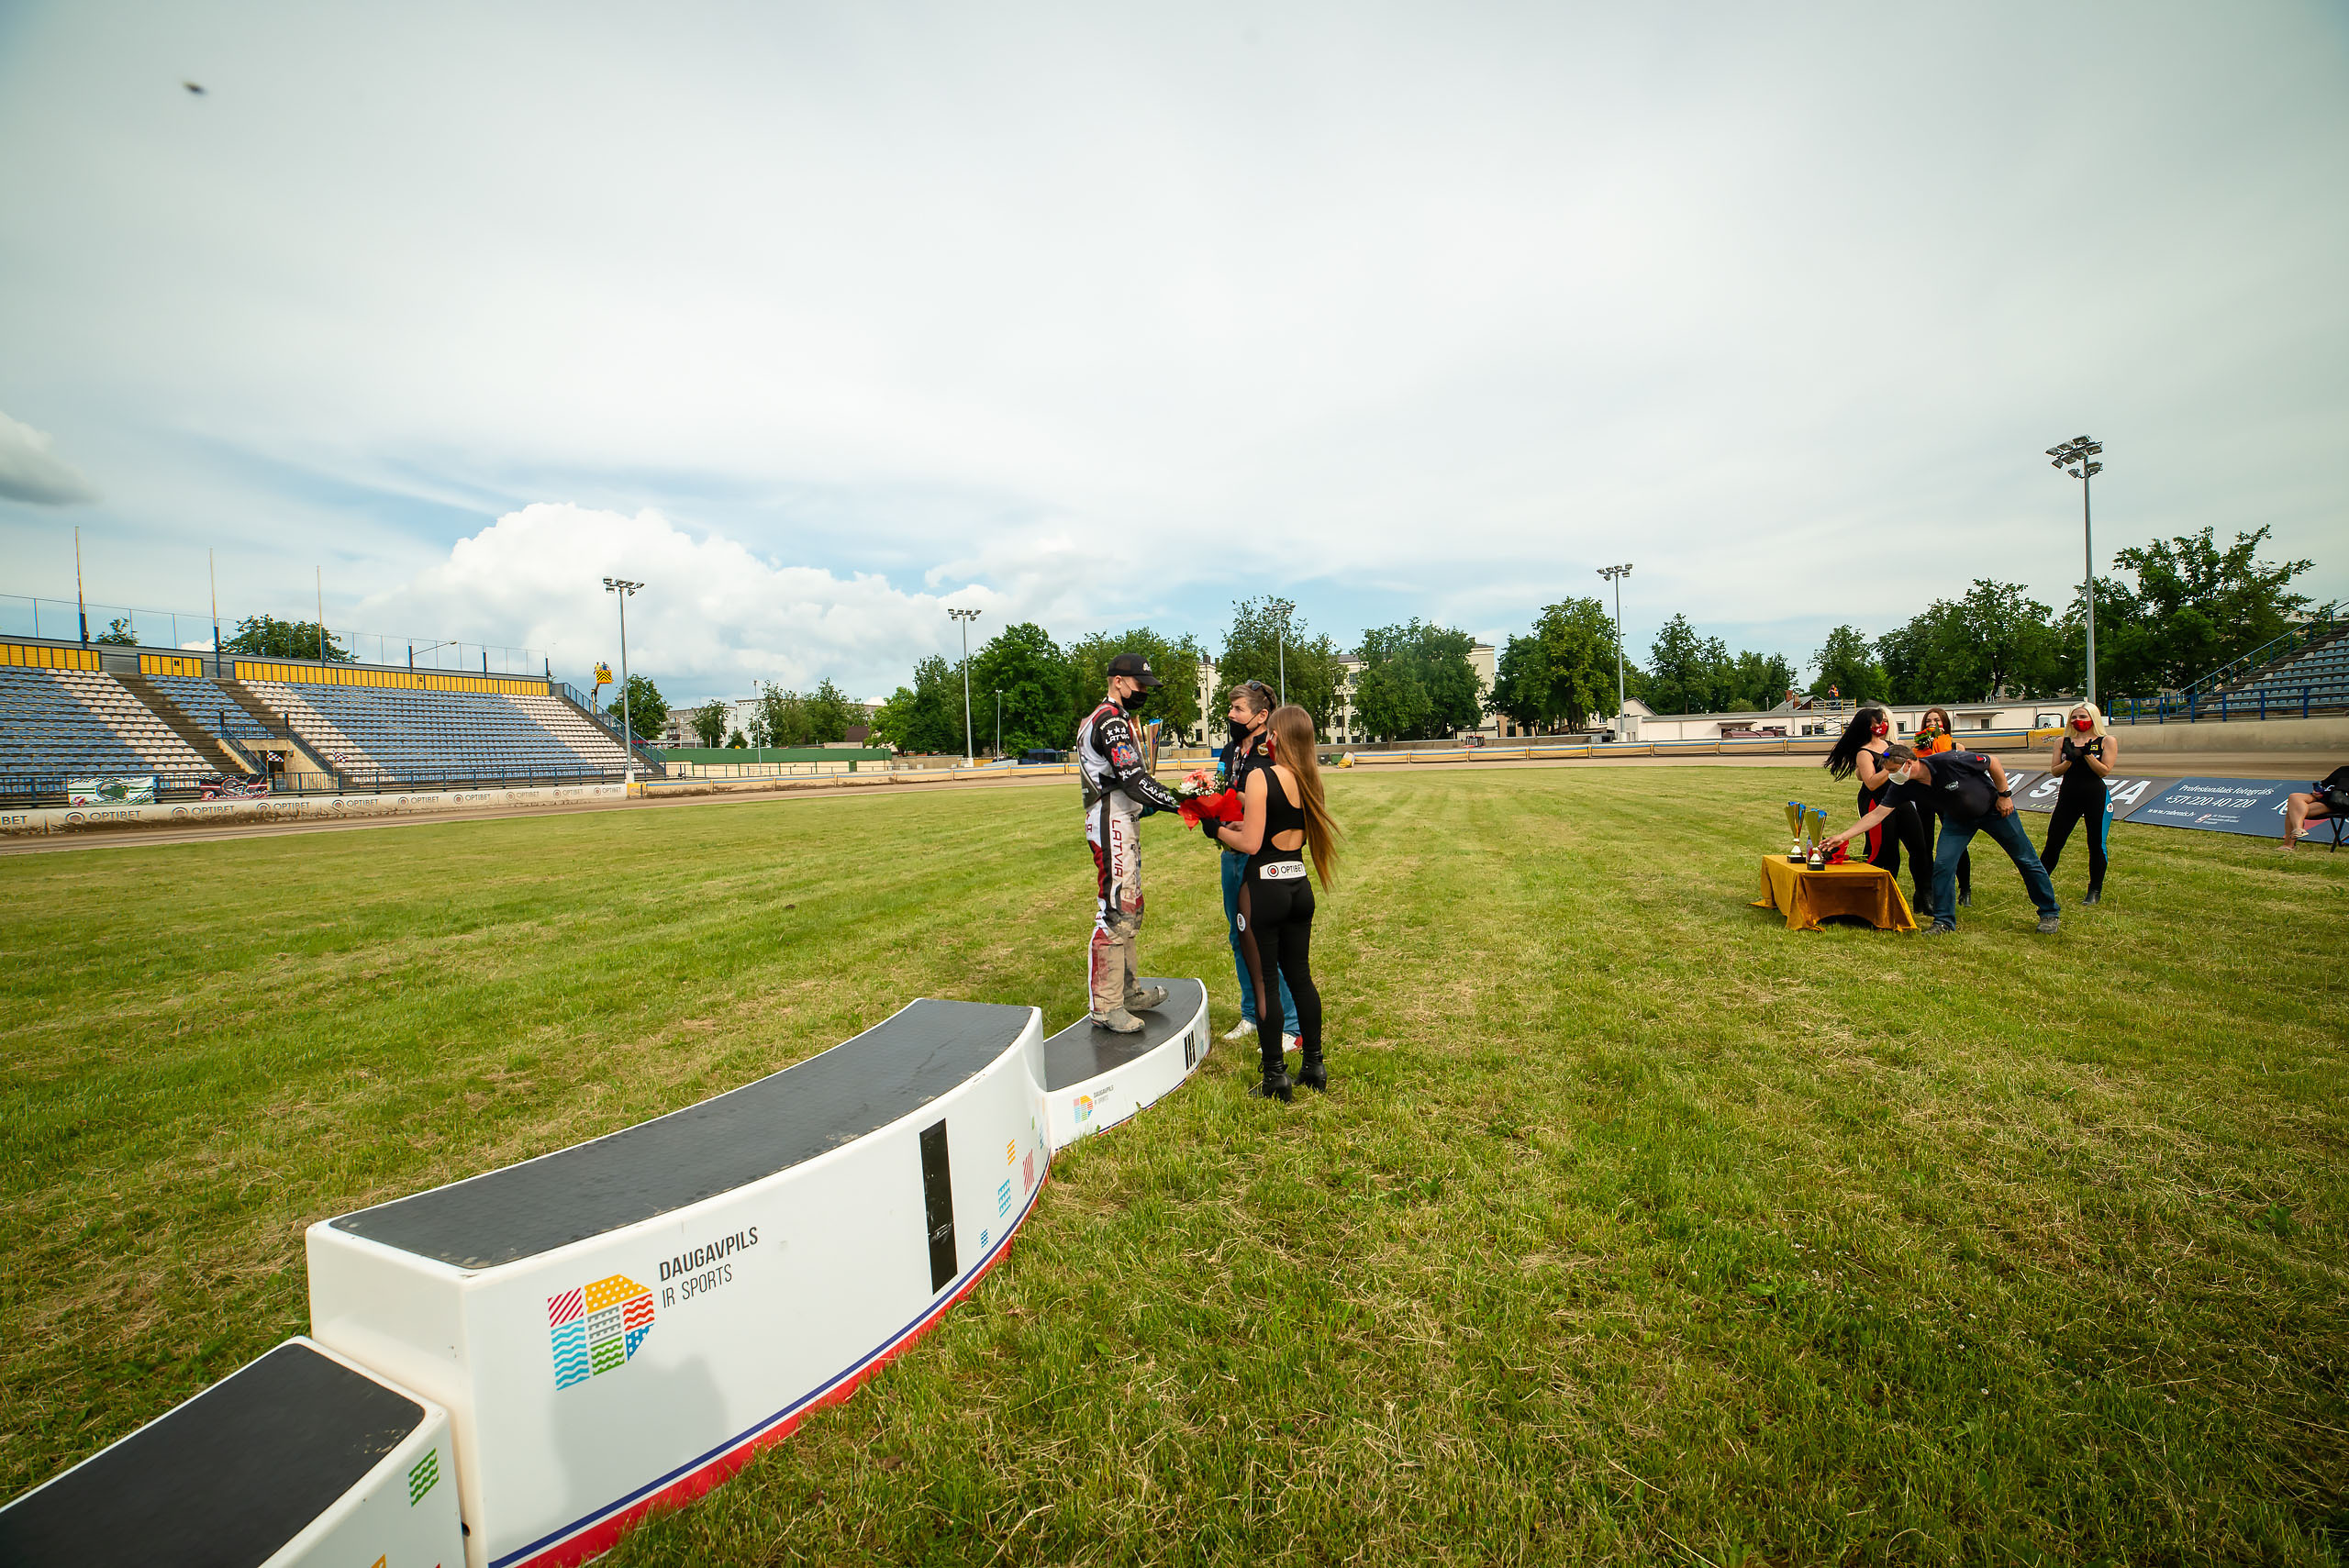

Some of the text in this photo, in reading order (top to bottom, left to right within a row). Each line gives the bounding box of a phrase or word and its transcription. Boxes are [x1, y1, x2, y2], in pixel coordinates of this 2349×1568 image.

[273, 802, 310, 810] OPTIBET
[347, 799, 379, 807] OPTIBET
[2165, 795, 2257, 808] +371 220 40 720
[89, 810, 141, 821] OPTIBET
[192, 806, 235, 816] OPTIBET
[1111, 819, 1124, 878] LATVIA
[1280, 863, 1303, 874] OPTIBET
[658, 1226, 759, 1283] DAUGAVPILS
[662, 1263, 733, 1309] IR SPORTS
